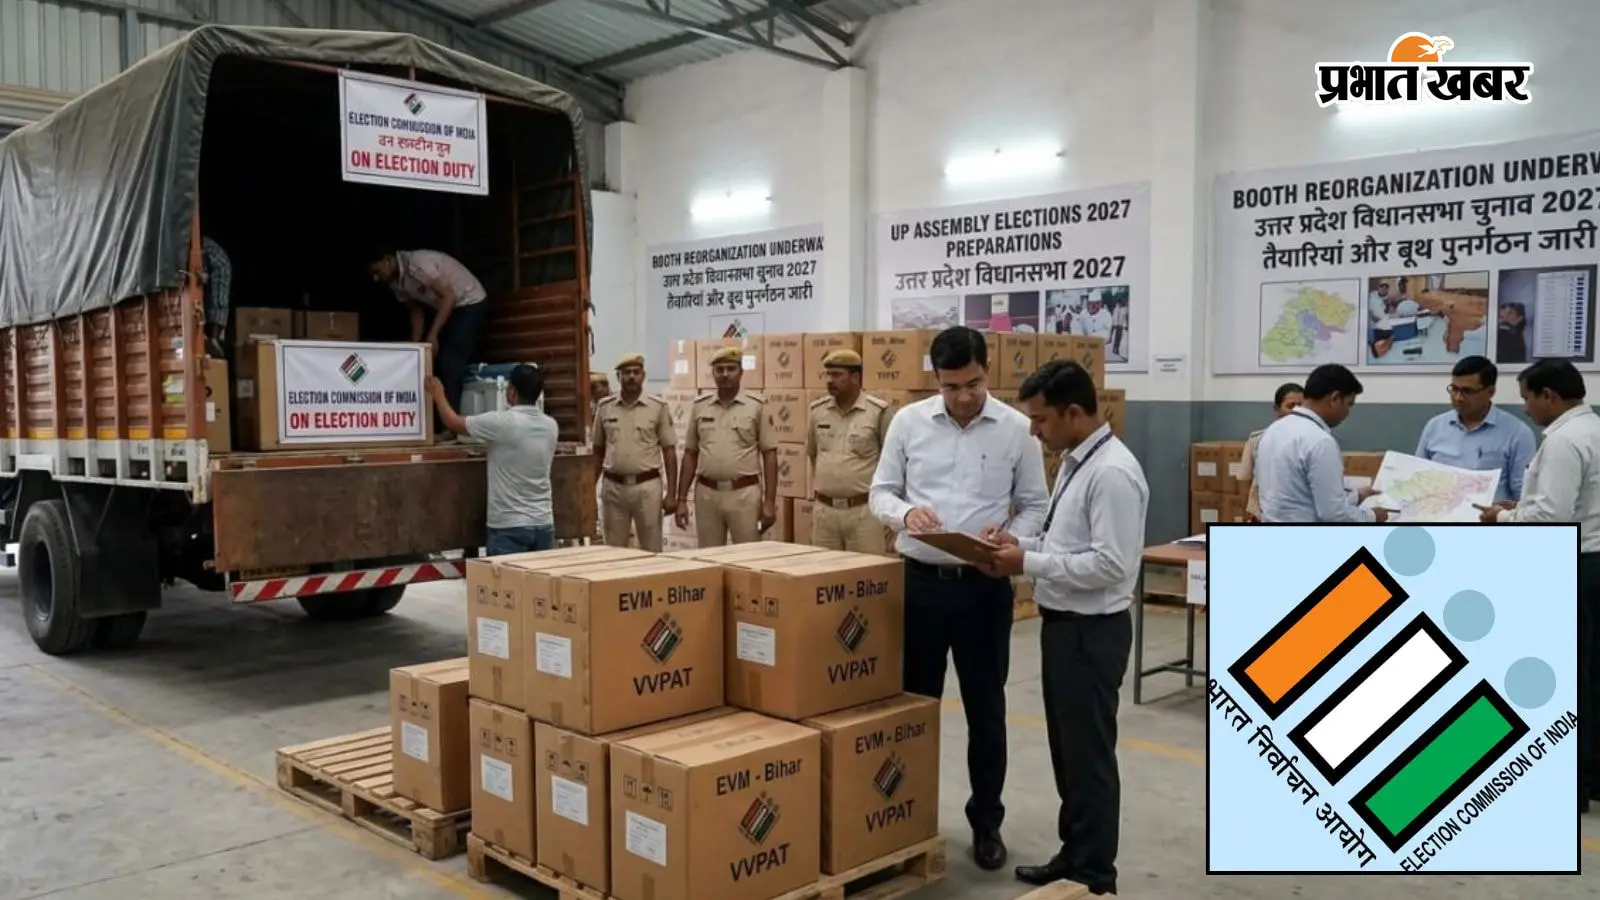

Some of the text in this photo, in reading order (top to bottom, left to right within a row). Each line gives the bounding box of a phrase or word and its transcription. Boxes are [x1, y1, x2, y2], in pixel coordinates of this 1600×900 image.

[349, 111, 389, 129] ELECTION
[351, 150, 475, 179] ON ELECTION DUTY
[1233, 184, 1298, 209] BOOTH
[1304, 163, 1495, 202] REORGANIZATION
[891, 199, 1131, 241] UP ASSEMBLY ELECTIONS 2027
[1255, 215, 1293, 238] उत्तर
[1299, 207, 1347, 234] प्रदेश
[1353, 201, 1465, 229] विधानसभा
[1471, 193, 1535, 226] चुनाव
[684, 242, 767, 264] REORGANIZATION
[770, 236, 824, 256] UNDERWA
[947, 232, 1062, 257] PREPARATIONS
[1263, 219, 1598, 270] तैयारियां और बूथ पुनर्गठन जारी
[787, 260, 817, 277] 2027
[895, 256, 1126, 291] उत्तर प्रदेश विधानसभा 2027
[288, 391, 417, 405] ELECTION COMMISSION OF INDIA
[290, 411, 416, 429] ON ELECTION DUTY
[619, 590, 653, 612] EVM
[668, 585, 706, 605] Bihar
[816, 583, 845, 605] EVM
[856, 579, 889, 598] Bihar
[633, 667, 694, 696] VVPAT
[828, 656, 878, 684] VVPAT
[855, 730, 883, 754] EVM
[895, 722, 927, 743] Bihar
[716, 769, 750, 796] EVM
[765, 758, 803, 782] Bihar
[865, 799, 915, 832] VVPAT
[730, 843, 790, 882] VVPAT
